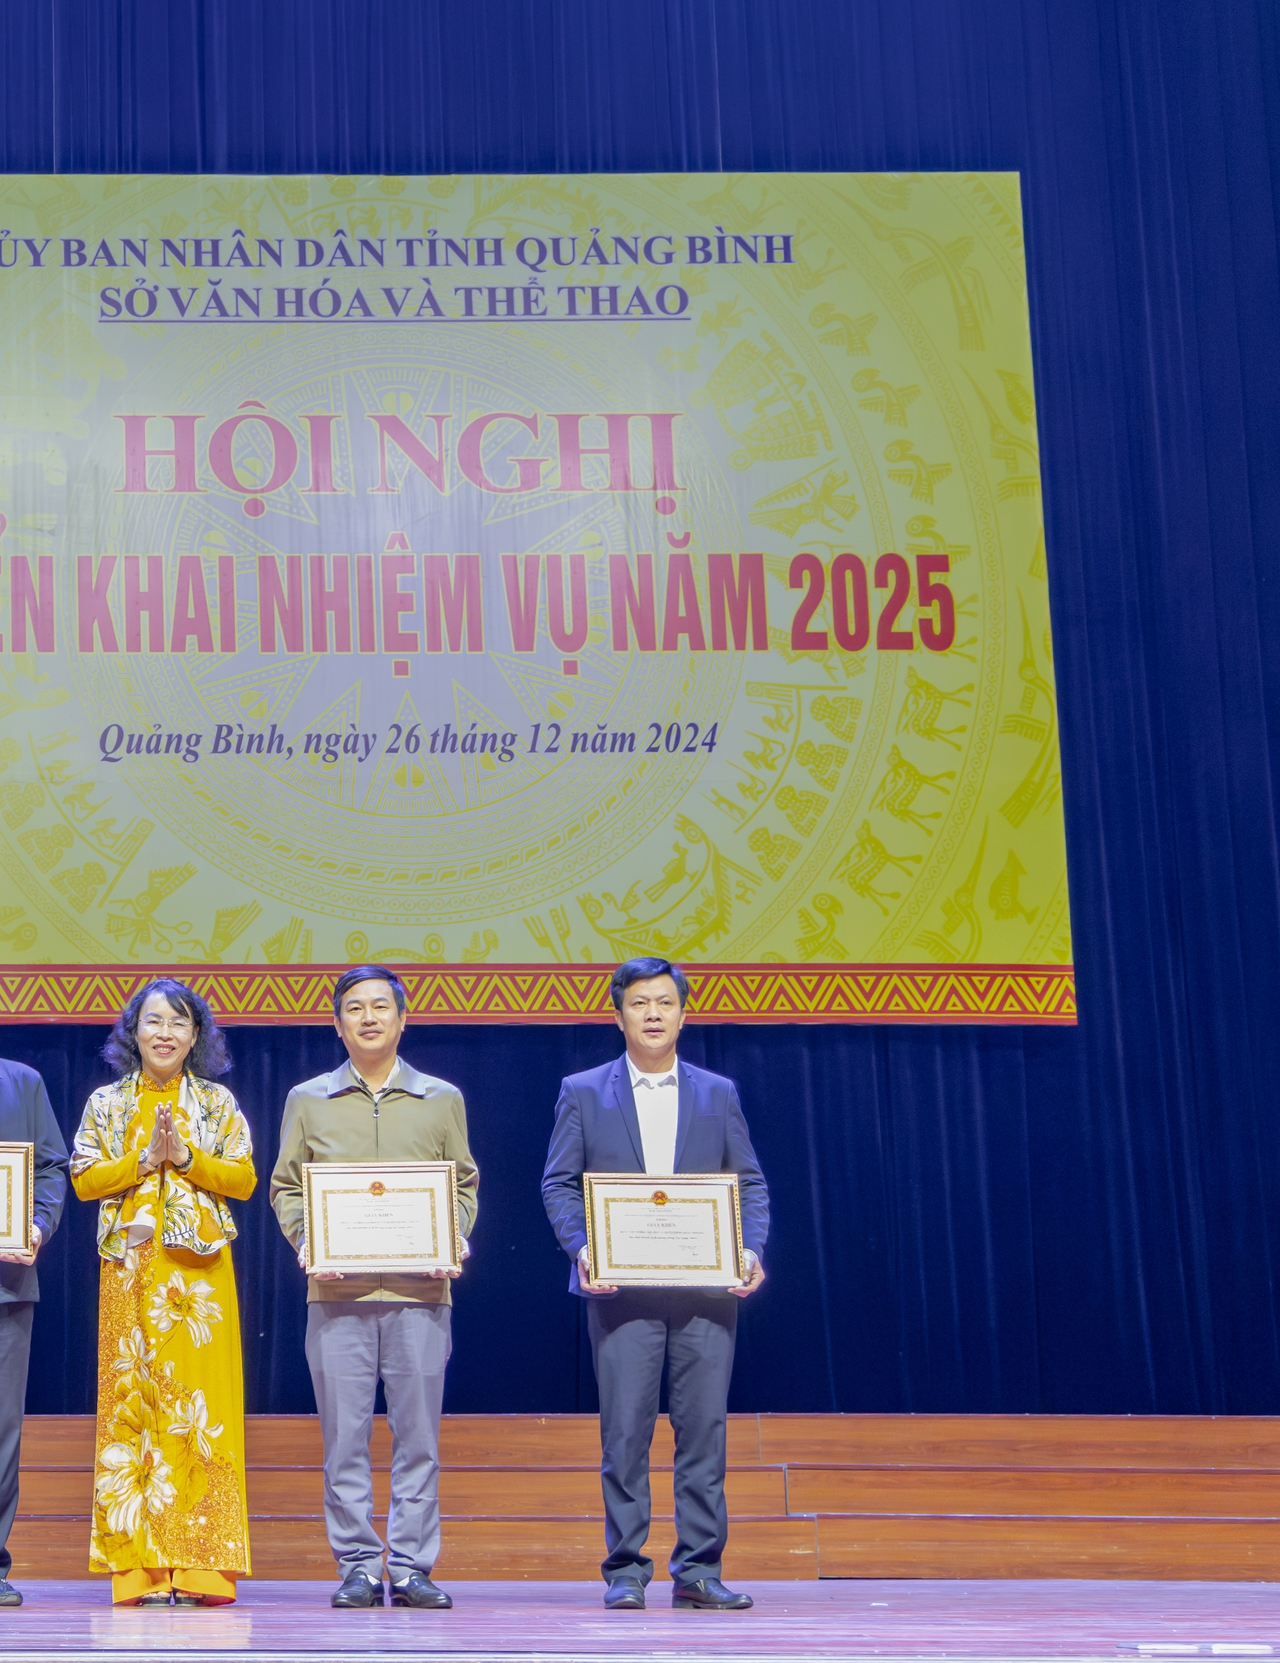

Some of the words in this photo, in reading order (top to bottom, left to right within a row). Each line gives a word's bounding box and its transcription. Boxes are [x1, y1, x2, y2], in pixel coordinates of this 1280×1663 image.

[60, 238, 149, 268] BAN
[159, 228, 284, 268] NHÂN
[295, 228, 386, 268] DÂN
[396, 229, 505, 267] TỈNH
[516, 227, 676, 273] QUẢNG
[685, 225, 794, 265] BÌNH
[99, 277, 160, 318] SỞ
[166, 278, 263, 318] VĂN
[274, 277, 375, 318] HÓA
[380, 277, 446, 318] VÀ
[455, 276, 548, 317] THỂ
[557, 285, 689, 316] THAO
[113, 400, 342, 518] HỘI
[367, 412, 687, 516] NGHỊ
[77, 555, 236, 653] KHAI
[258, 533, 483, 676] NHIỆM
[501, 554, 588, 676] VỤ
[609, 531, 769, 652] NĂM
[788, 553, 956, 653] 2025
[99, 723, 203, 764] Quảng
[210, 723, 294, 761] Bình,
[303, 723, 378, 764] ngày
[384, 723, 421, 755] 26
[429, 722, 518, 763] tháng
[527, 722, 562, 754] 12
[570, 723, 636, 754] năm
[644, 722, 719, 754] 2024
